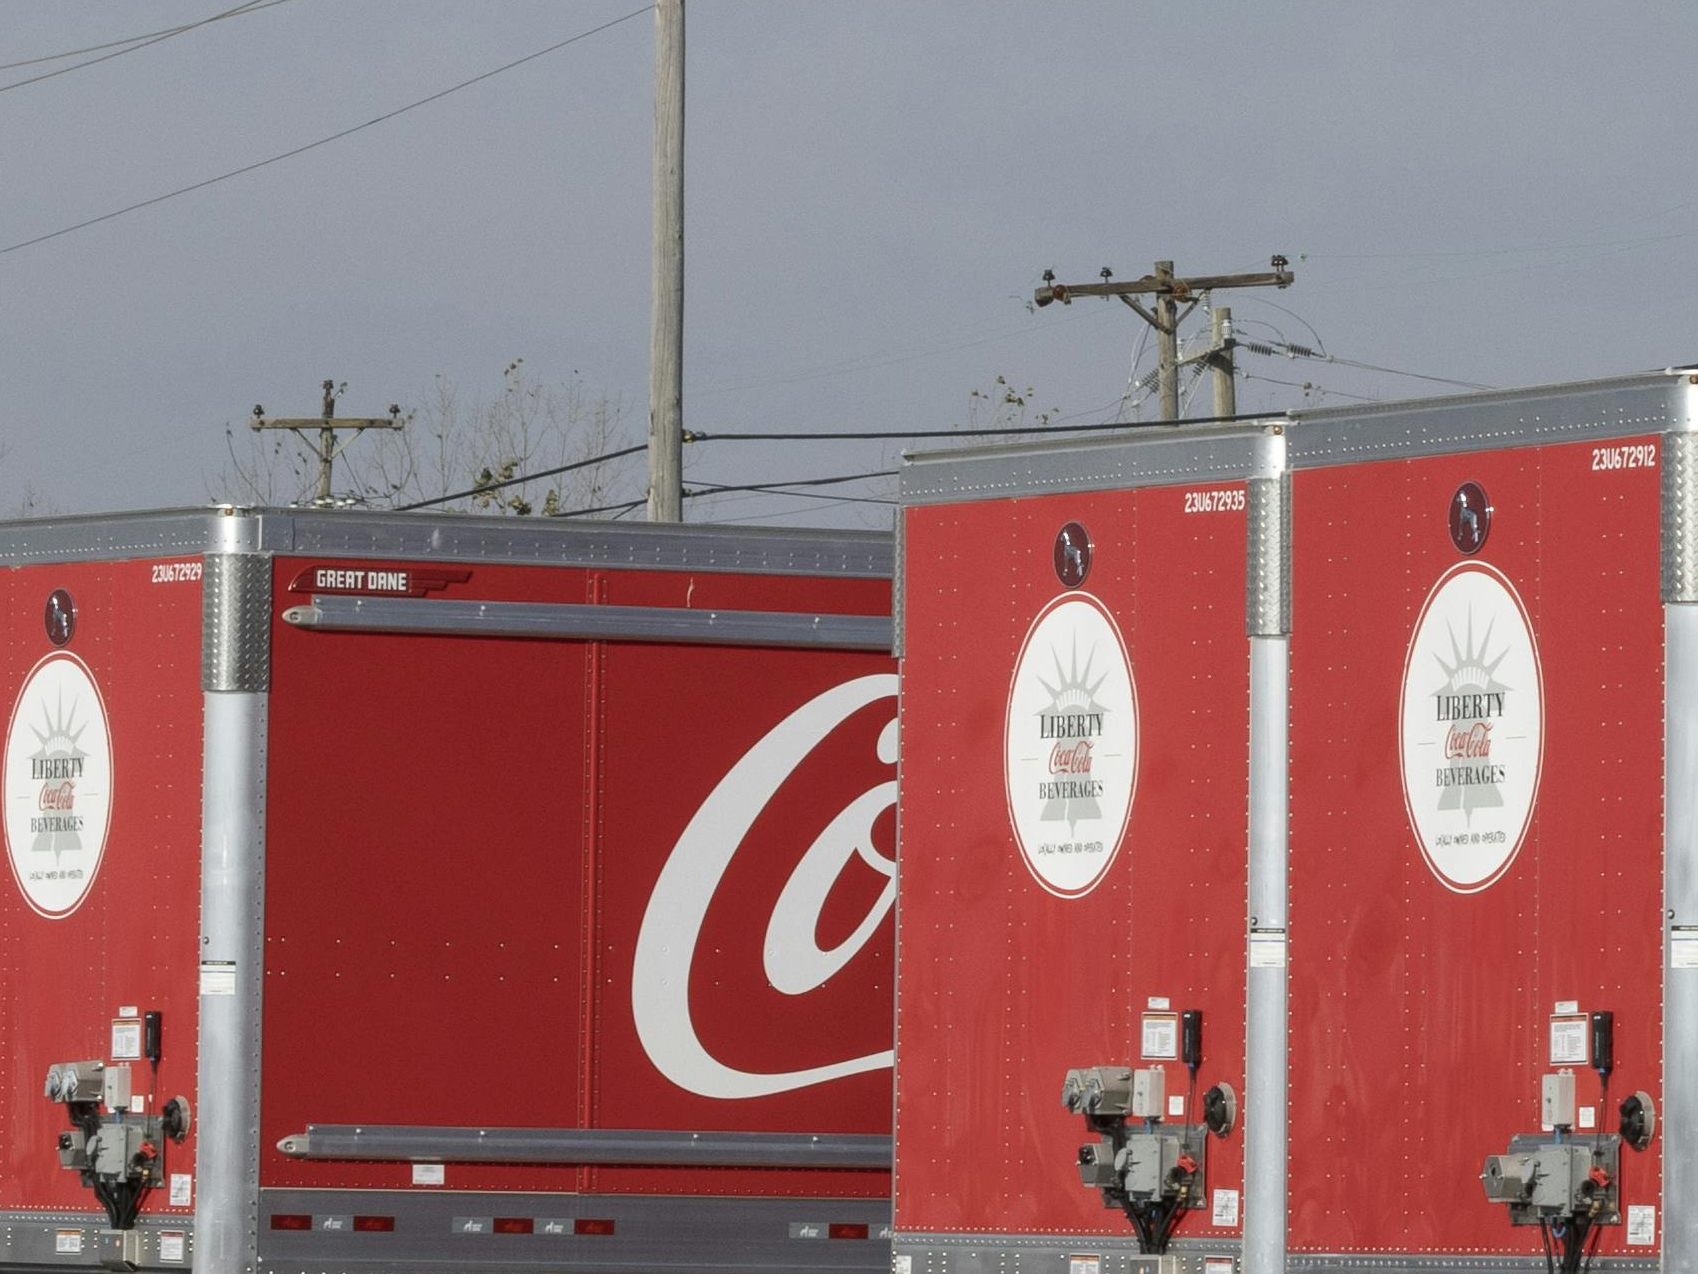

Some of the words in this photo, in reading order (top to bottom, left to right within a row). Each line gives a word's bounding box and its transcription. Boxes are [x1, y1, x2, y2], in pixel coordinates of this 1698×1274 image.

[1592, 444, 1656, 471] 23U672912
[1184, 489, 1246, 513] 23U672935
[151, 562, 202, 583] 23U672929
[316, 569, 363, 589] GREAT
[367, 571, 407, 591] DANE
[1435, 692, 1506, 721] LIBERTY
[1039, 713, 1104, 739] LIBERTY
[32, 757, 85, 780] LIBERTY
[1435, 764, 1506, 787] BEVERAGES
[1039, 779, 1104, 800] BEVERAGES
[30, 816, 85, 833] BEVERAGES
